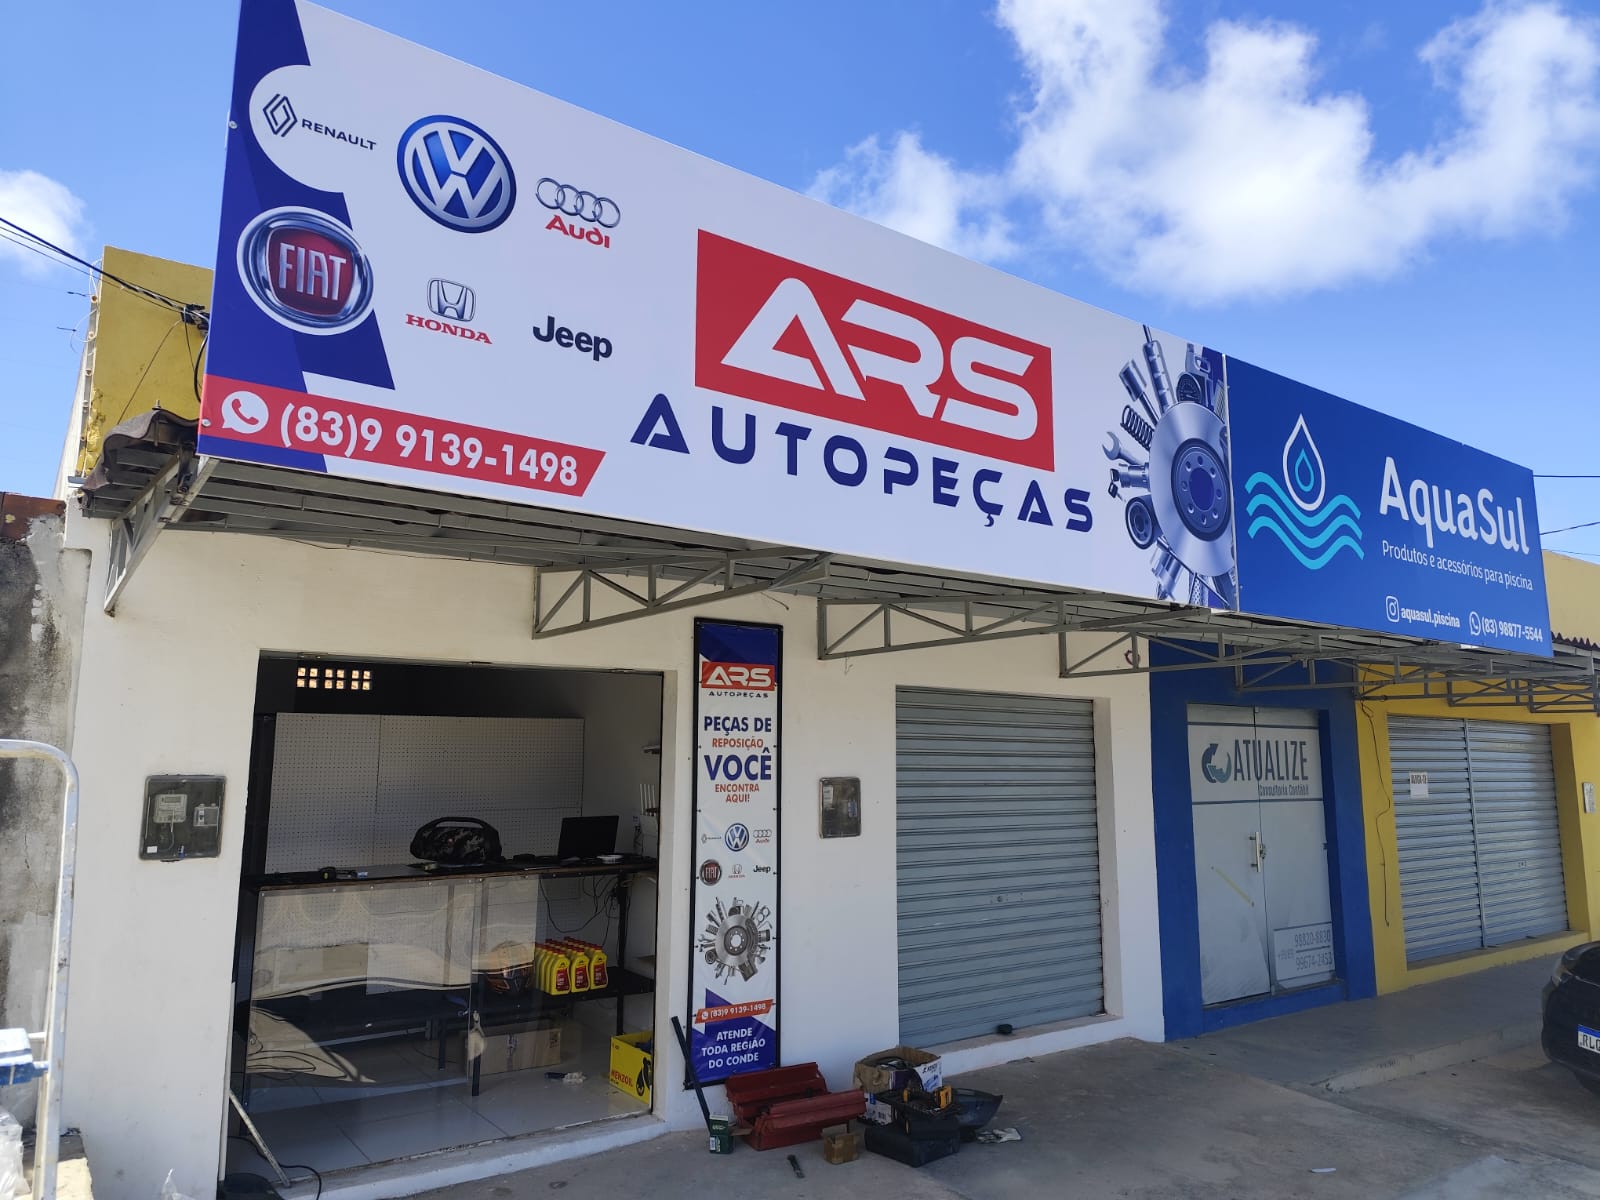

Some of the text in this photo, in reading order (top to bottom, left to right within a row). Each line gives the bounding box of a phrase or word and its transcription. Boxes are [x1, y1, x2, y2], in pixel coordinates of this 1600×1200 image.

[301, 118, 377, 150] RENAULT
[544, 214, 611, 249] Audi
[278, 242, 347, 302] FIAT
[405, 313, 493, 345] HONDA
[532, 316, 613, 361] Jeep
[720, 277, 1038, 440] ARS
[280, 402, 578, 487] (83)9 9139-1498
[630, 393, 1093, 533] AUTOPEÇAS
[1379, 456, 1529, 555] AquaSul
[1382, 539, 1534, 591] Produtos e acessórios para piscina
[1400, 607, 1461, 628] aquasul.piscina
[1481, 616, 1543, 643] (83) 98877-5544
[705, 665, 772, 687] ARS
[708, 690, 769, 698] AUTOPEÇAS
[703, 716, 772, 736] PEÇAS DE
[712, 736, 764, 750] REPOSIÇÃO
[703, 747, 772, 781] VOCÊ
[1233, 739, 1309, 782] ATUALIZE
[714, 783, 760, 793] ENCONTRA
[725, 794, 750, 803] AQUI!
[705, 866, 717, 879] FIAT
[753, 865, 771, 873] Jeep
[710, 1003, 767, 1018] (83)9 9139-1498
[716, 1027, 753, 1042] ATENDE
[701, 1037, 766, 1057] TODA REGIÃO
[708, 1052, 760, 1069] DO CONDE
